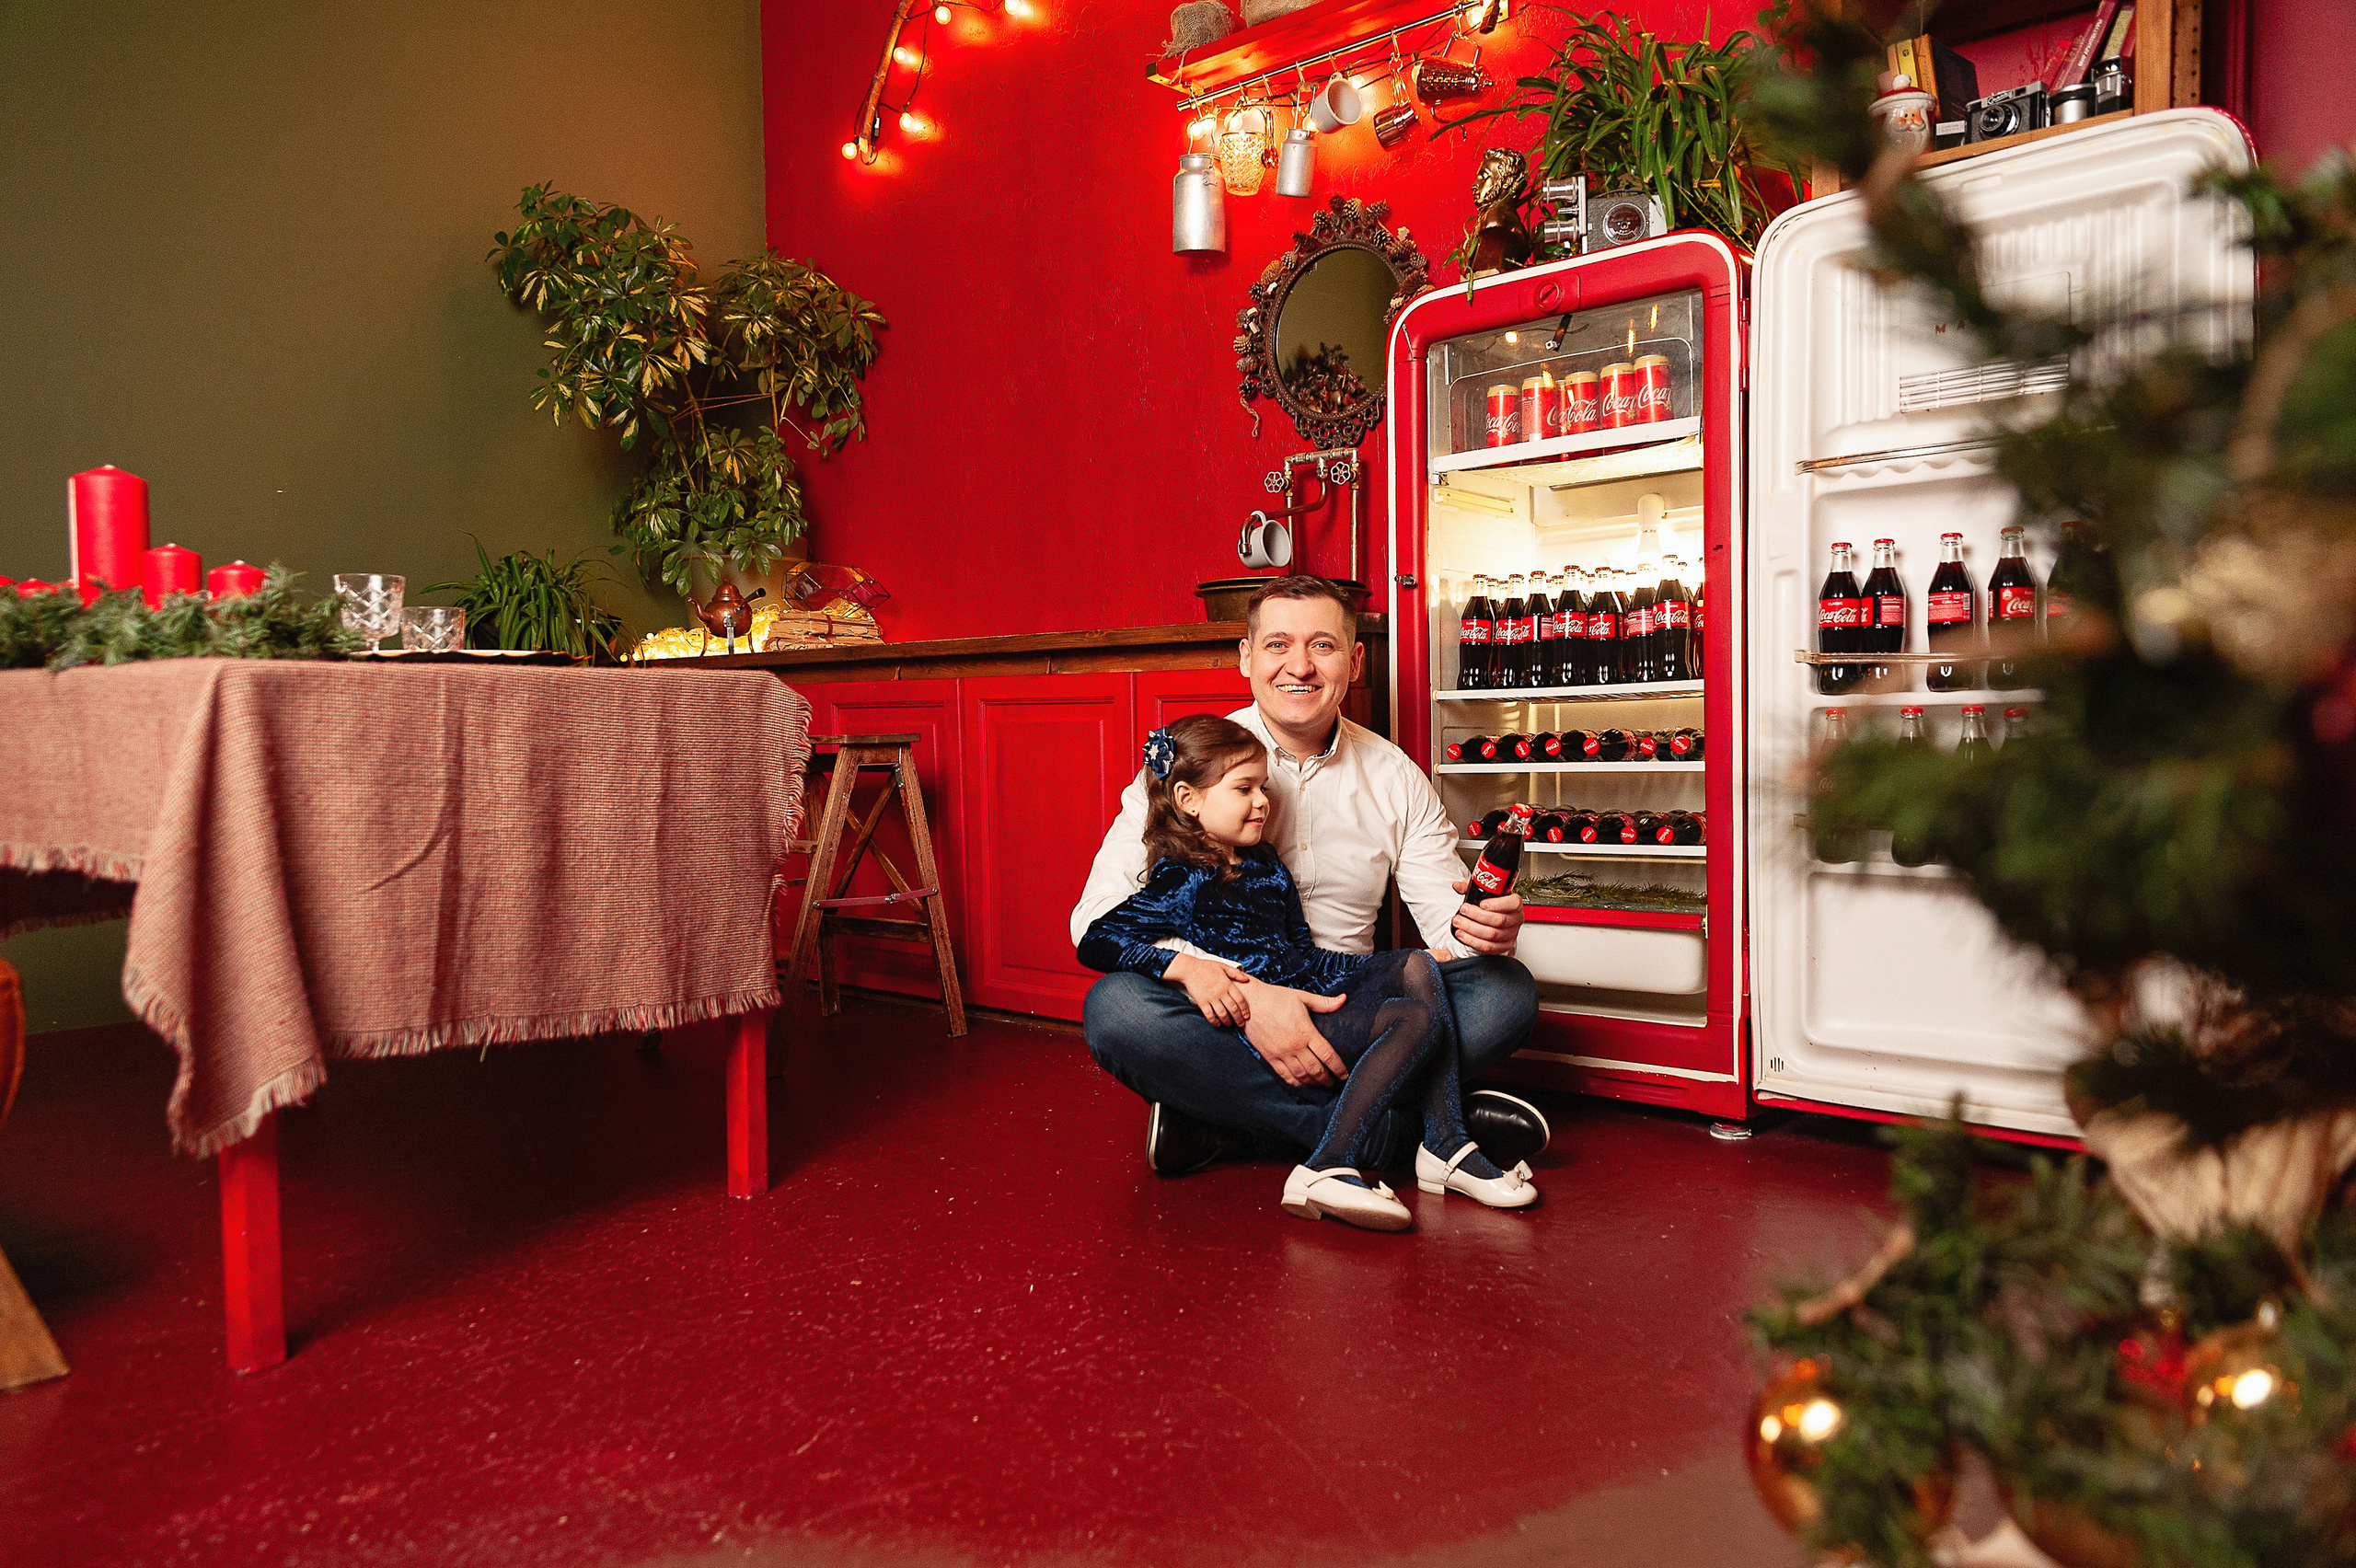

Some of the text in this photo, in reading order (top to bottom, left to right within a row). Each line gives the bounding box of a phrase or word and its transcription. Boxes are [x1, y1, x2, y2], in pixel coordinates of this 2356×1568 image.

[1602, 392, 1635, 417] Coca-
[1638, 384, 1672, 409] Coca-
[1485, 411, 1519, 437] oca-Co
[1819, 606, 1858, 625] Coca-Cola
[2006, 597, 2034, 614] Coca-
[1496, 627, 1523, 640] CocaCo
[1553, 619, 1585, 634] CocaCola
[1473, 865, 1502, 891] ca-Cola
